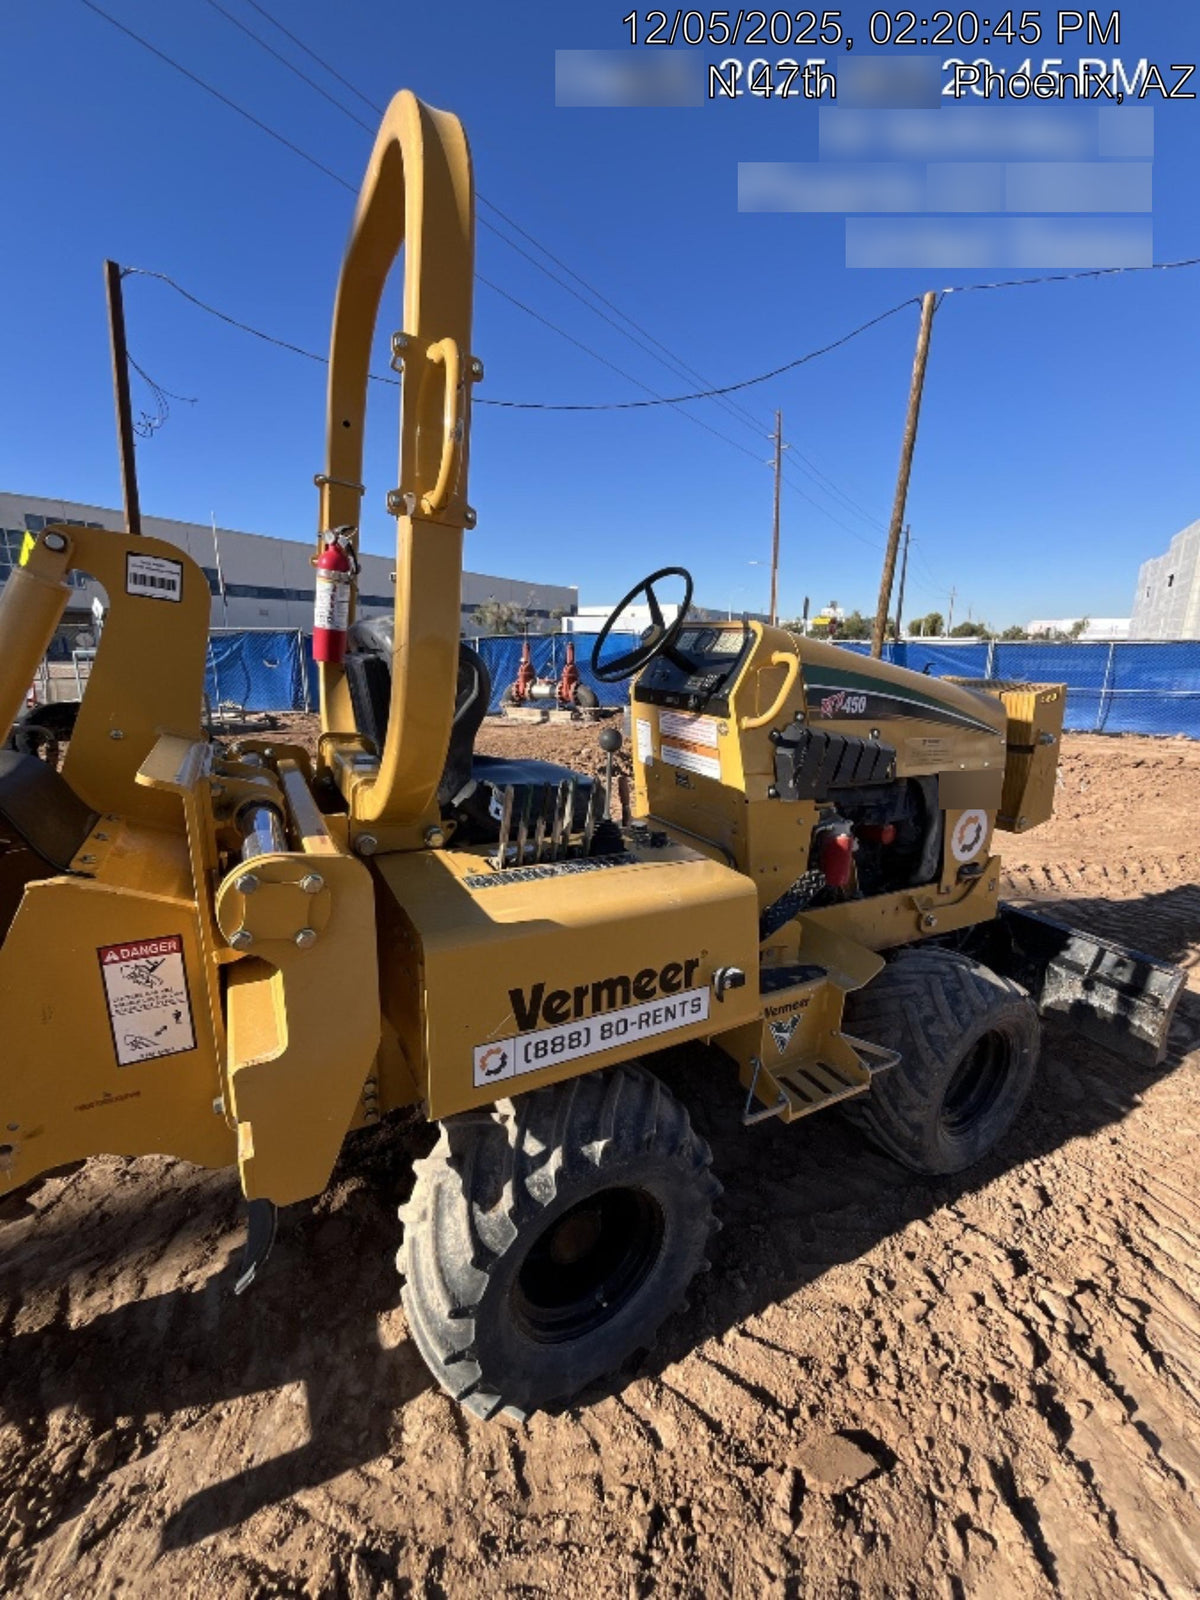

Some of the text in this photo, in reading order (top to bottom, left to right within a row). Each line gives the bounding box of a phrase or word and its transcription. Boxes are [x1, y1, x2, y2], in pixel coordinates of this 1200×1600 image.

[119, 940, 178, 960] DANGER
[508, 957, 700, 1032] Vermeer
[764, 998, 811, 1018] Vermeer
[523, 996, 702, 1064] (888) 80-RENTS
